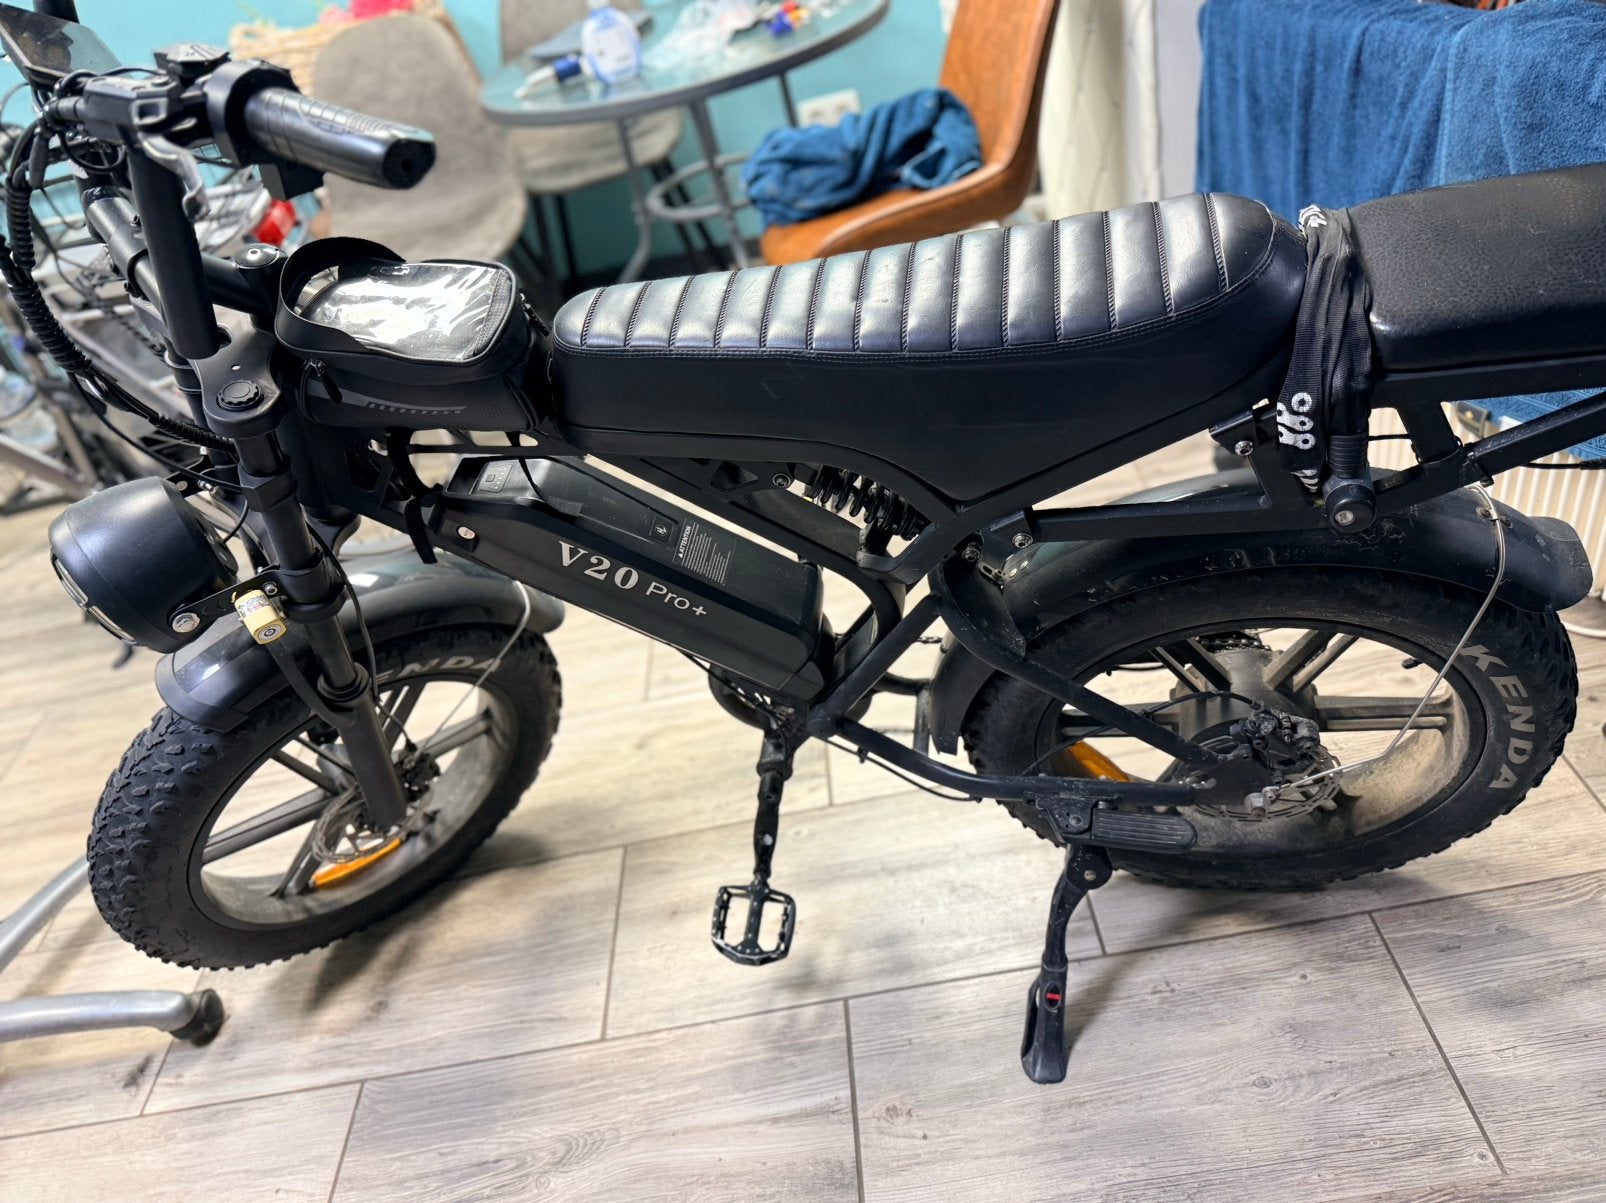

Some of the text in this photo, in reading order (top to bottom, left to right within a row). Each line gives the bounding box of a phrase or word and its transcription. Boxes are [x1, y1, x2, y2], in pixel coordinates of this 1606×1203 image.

[680, 525, 692, 553] ATTENTION
[558, 540, 639, 590] V20
[645, 581, 707, 616] Pro+
[1456, 644, 1536, 789] KENDA
